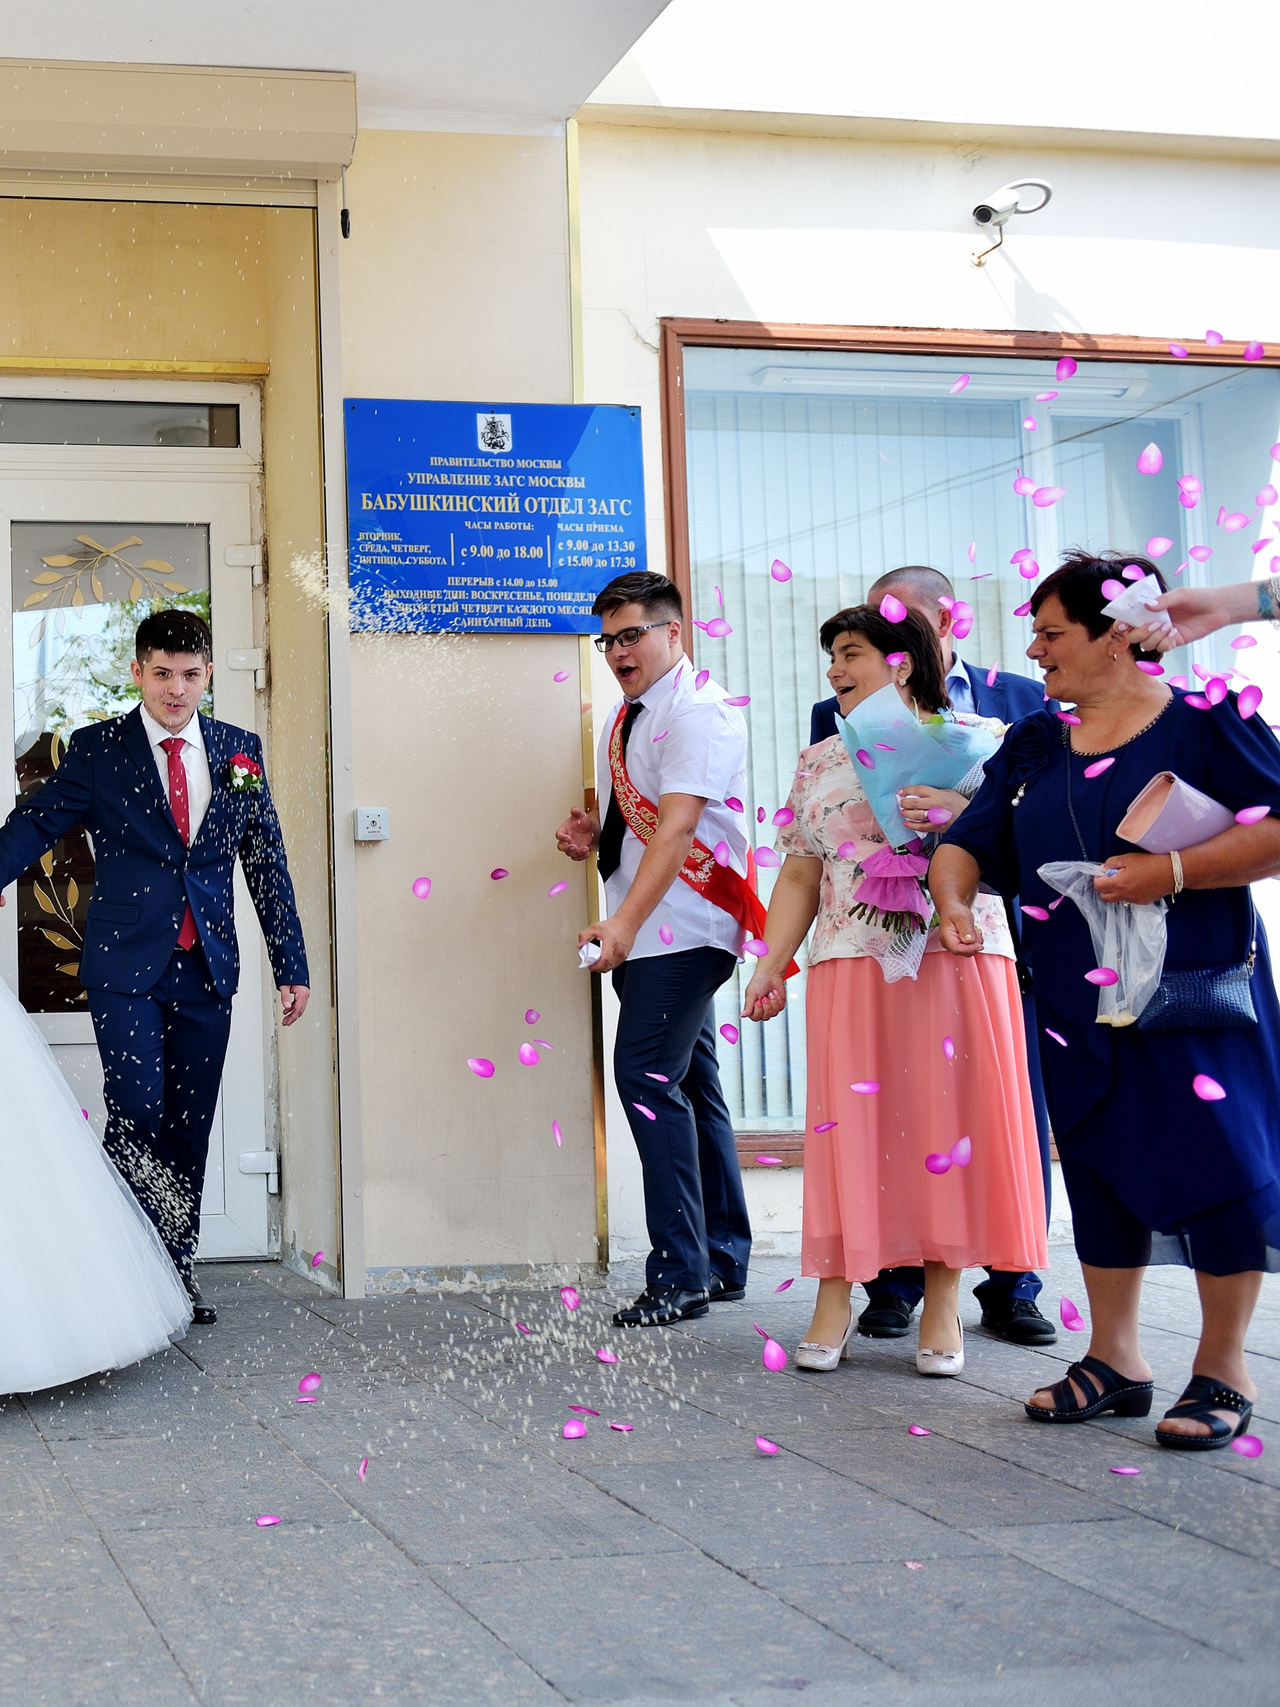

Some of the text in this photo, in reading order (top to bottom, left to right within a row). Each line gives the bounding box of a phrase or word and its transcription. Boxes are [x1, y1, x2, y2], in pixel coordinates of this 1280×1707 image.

[430, 457, 562, 469] ПРАВИТЕЛЬСТВО МОСКВЫ
[407, 472, 586, 488] УПРАВЛЕНИЕ ЗАГС МОСКВЫ
[361, 492, 632, 518] БАБУШКИНСКИЙ ОТДЕЛ ЗАГС
[464, 521, 535, 531] ЧАСЫ РАБОТЫ:
[557, 523, 625, 533] ЧАСЫ ПРИЕМА
[359, 532, 403, 541] ВТОРНИК,
[359, 544, 432, 554] СРЕДА, ЧЕТВЕРГ,
[557, 539, 636, 552] с 9.00 до 13.30
[461, 545, 544, 559] с 9.00 до 18.00
[406, 556, 448, 565] СУББОТА
[558, 556, 636, 568] с 15.00 до 17.30
[447, 577, 494, 587] ПЕРЕРЫВ
[503, 578, 524, 587] 14.00
[525, 579, 535, 588] до
[537, 579, 558, 588] 15.00
[384, 589, 597, 602] ВЫХОДНЫЕ ДНИ: ВОСКРЕСЕНЬЕ, ПОНЕДЕЛЬ
[461, 604, 505, 613] ЧЕТВЕРГ
[507, 604, 556, 615] КАЖДОГО
[557, 606, 593, 615] МЕСЯЦ
[454, 615, 552, 628] САНИТАРНЫЙ ДЕНЬ
